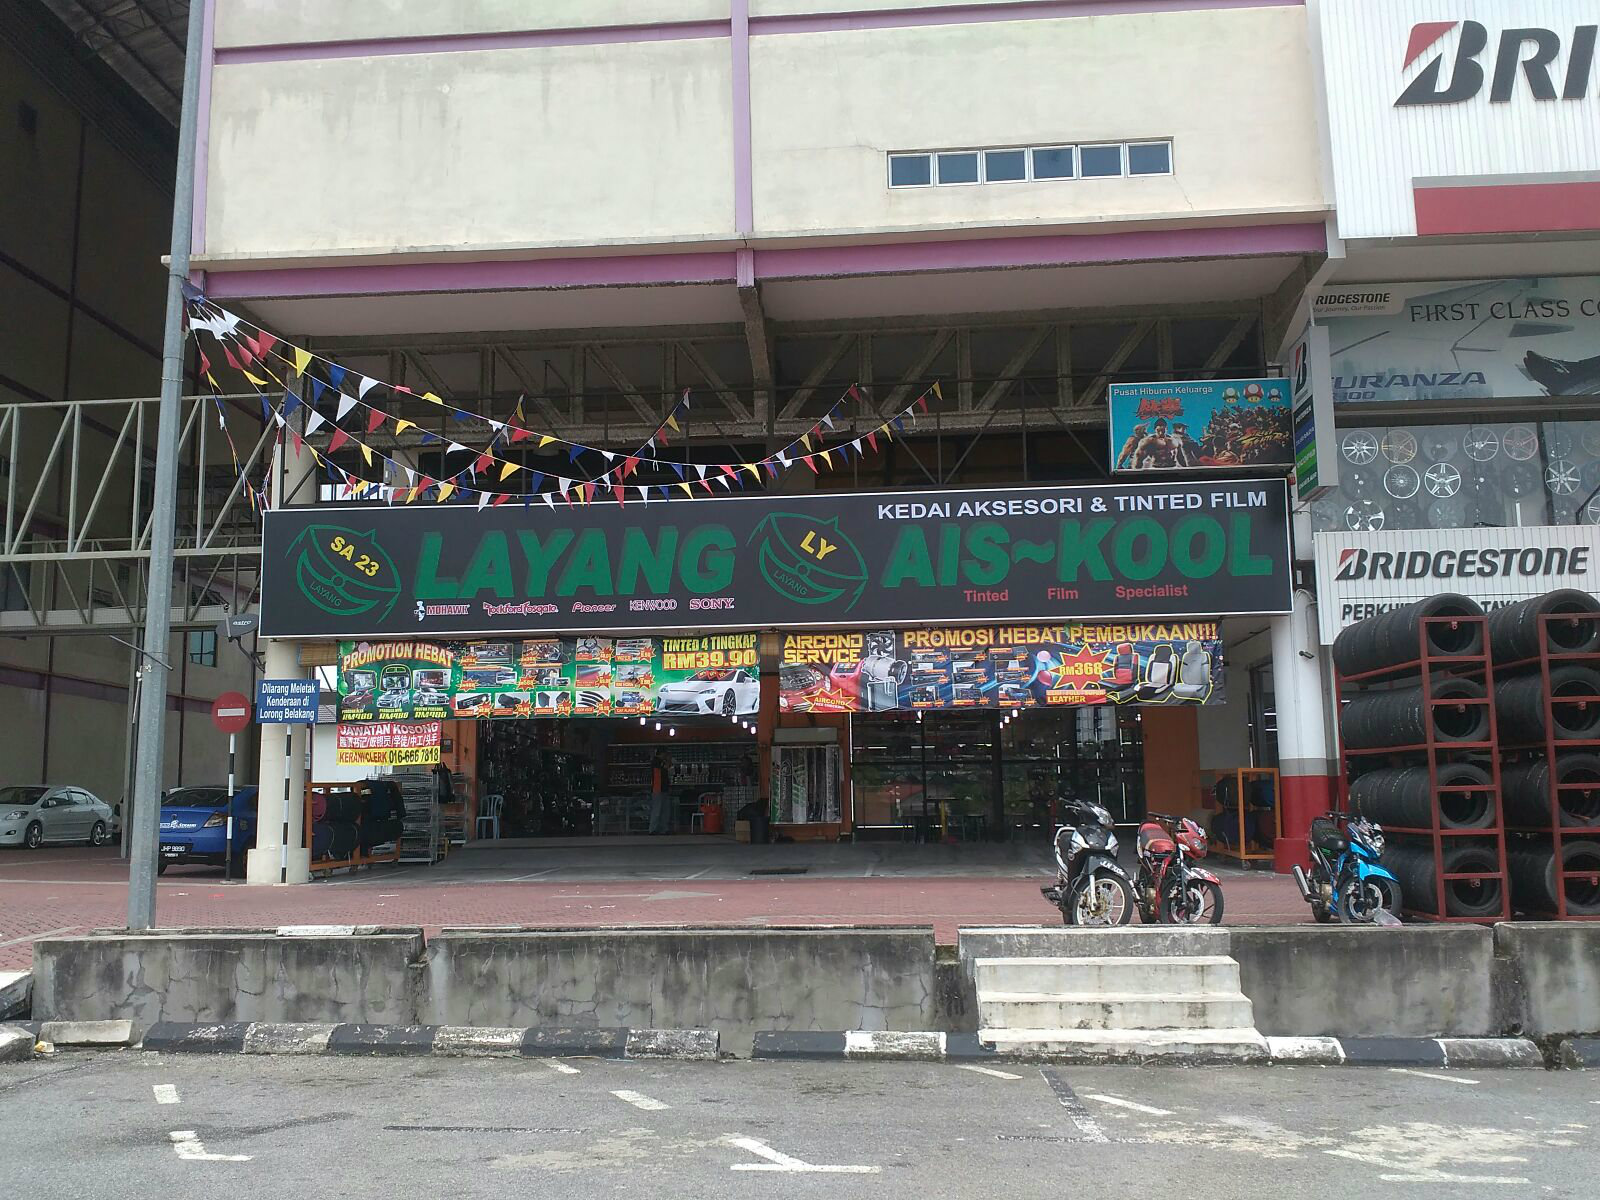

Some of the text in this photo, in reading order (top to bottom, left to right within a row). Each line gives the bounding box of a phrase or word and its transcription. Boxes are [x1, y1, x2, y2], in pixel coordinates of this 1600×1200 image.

[1393, 20, 1600, 107] BRI
[1315, 292, 1391, 305] RIDGESTONE
[1410, 299, 1600, 322] FIRST CLASS C
[1331, 371, 1486, 390] URANZA
[1114, 386, 1213, 396] Pusat Hiburan Keluarga
[877, 492, 1267, 520] KEDAI AKSESORI & TINTED FILM
[800, 530, 838, 560] LY
[330, 536, 380, 577] SA 23
[413, 523, 737, 601] LAYANG
[1335, 546, 1590, 580] BRIDGESTONE
[773, 569, 808, 596] LAYANG
[310, 581, 341, 607] LAYANG
[963, 584, 1189, 602] Tinted Film Specialist
[426, 603, 471, 616] MOHAWK
[629, 599, 678, 612] KENWOOD
[689, 598, 735, 610] SONY
[663, 634, 757, 652] TINTED 4 TINGKAP
[784, 634, 864, 649] AIRCOND
[903, 623, 1218, 648] PROMOSI HEBAT PEMBUKAAN!!!
[342, 641, 454, 672] PROMOTION HEBAT
[663, 649, 757, 669] RM39.90
[784, 648, 862, 663] SERVICE
[261, 682, 316, 696] Dilarang Meletak
[266, 695, 310, 707] Kenderaan di
[1047, 695, 1086, 703] LEATHER
[259, 707, 315, 721] Lorong Belakang
[340, 722, 438, 736] JAWATAN KOSONG
